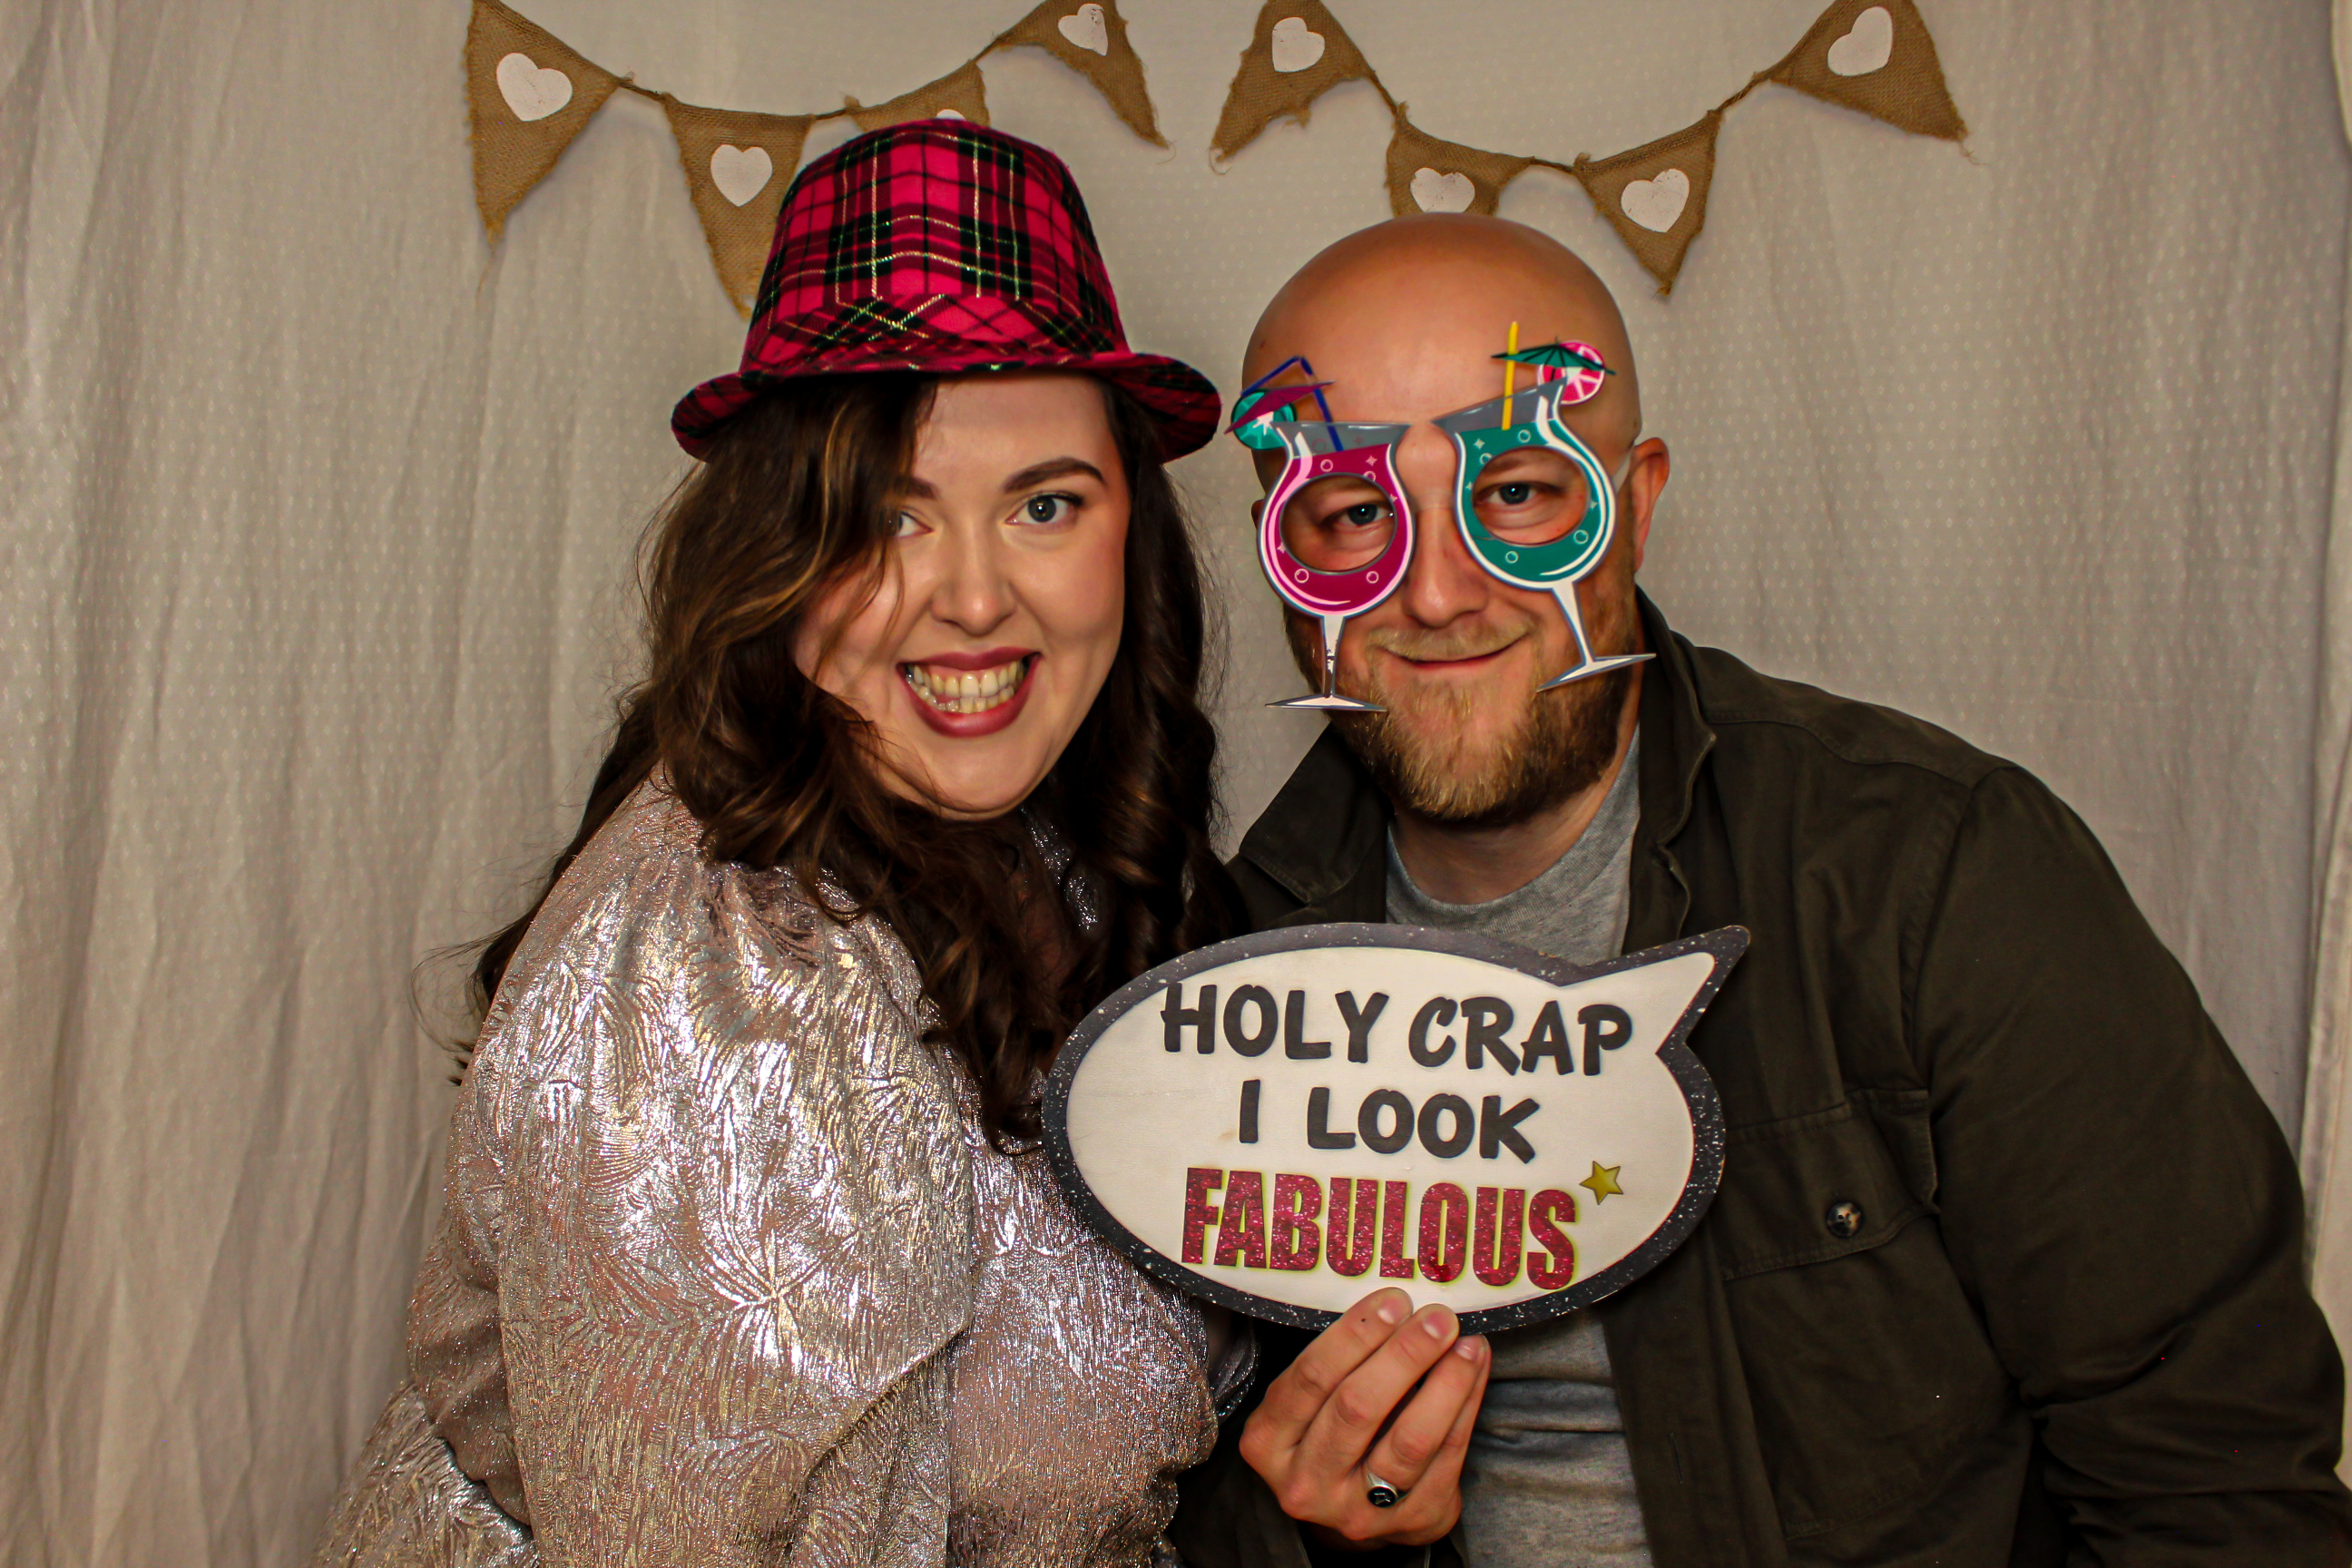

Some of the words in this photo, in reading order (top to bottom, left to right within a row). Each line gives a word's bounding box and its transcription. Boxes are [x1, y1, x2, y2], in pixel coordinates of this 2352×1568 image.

[1161, 983, 1389, 1063] HOLY
[1408, 996, 1633, 1076] CRAP
[1239, 1079, 1261, 1144] I
[1307, 1087, 1541, 1163] LOOK
[1181, 1167, 1577, 1290] FABULOUS
